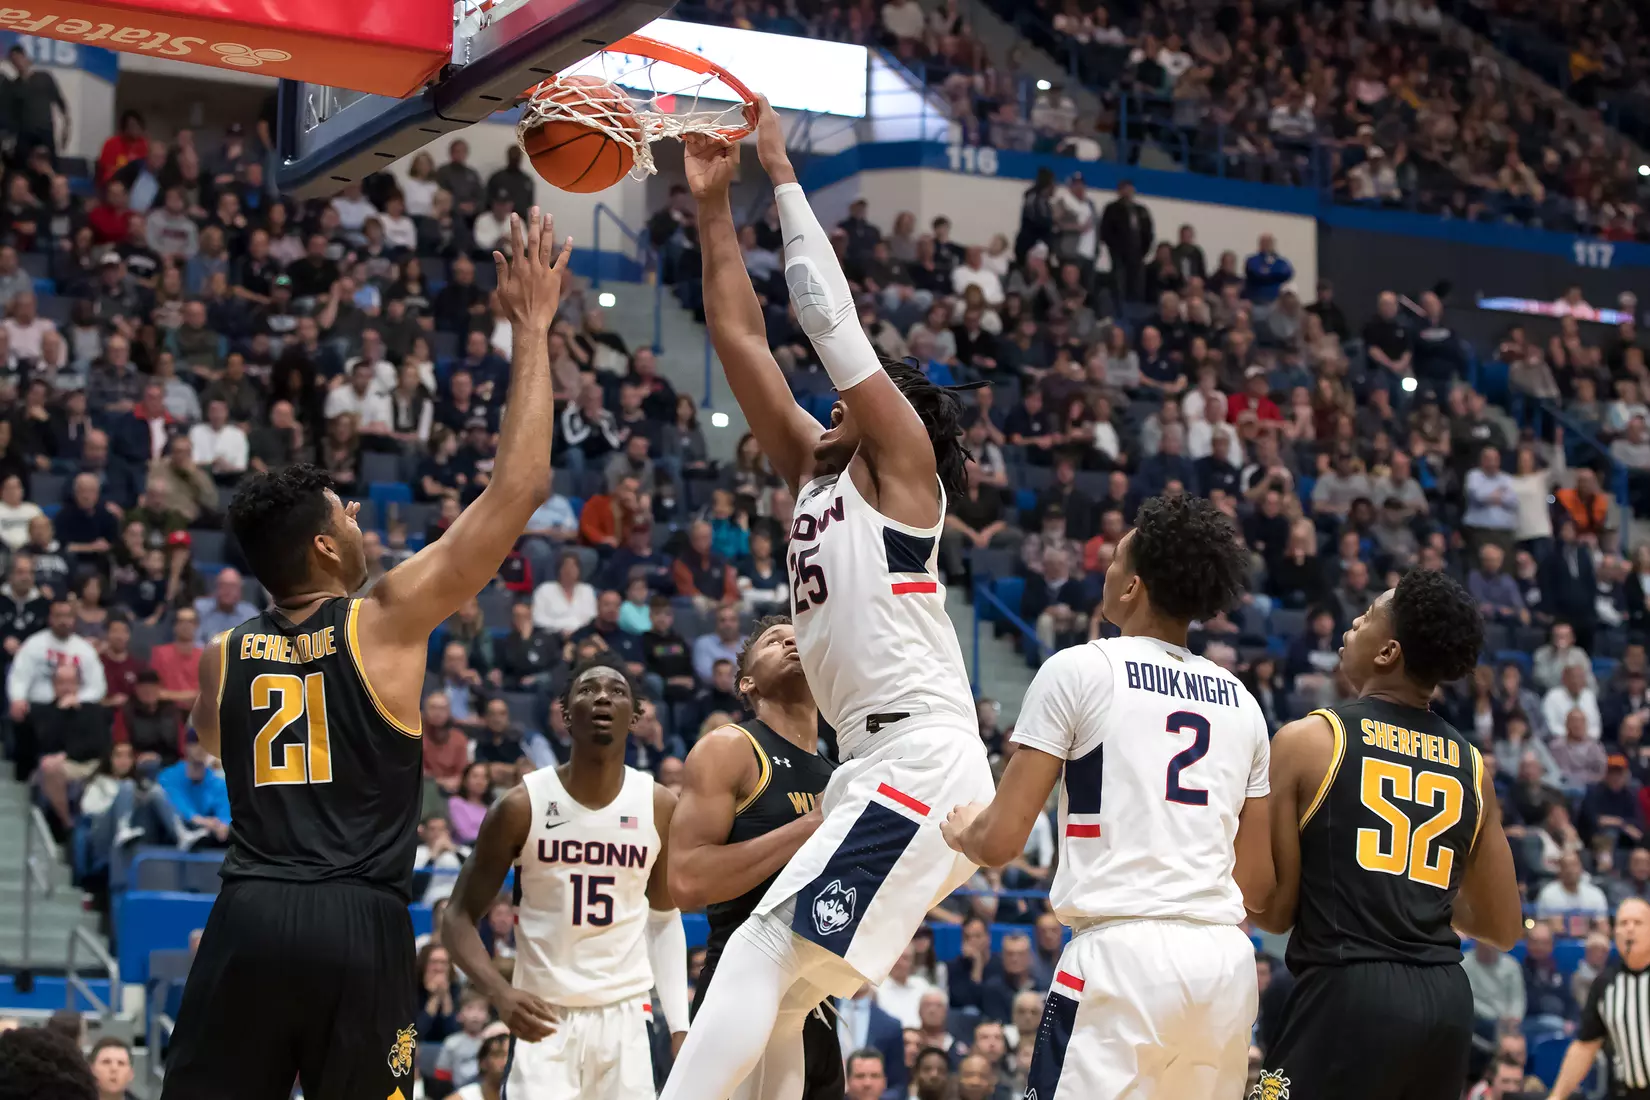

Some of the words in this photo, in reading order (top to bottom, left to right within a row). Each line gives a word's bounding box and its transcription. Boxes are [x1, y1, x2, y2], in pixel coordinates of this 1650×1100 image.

[946, 146, 999, 175] 116
[1573, 241, 1615, 269] 117
[790, 543, 829, 615] 25
[240, 625, 337, 665] ECHEQUE
[1125, 660, 1240, 708] BOUKNIGHT
[251, 671, 333, 788] 21
[1360, 718, 1460, 769] SHERFIELD
[1165, 710, 1211, 807] 2
[1356, 756, 1465, 891] 52
[537, 838, 648, 869] UCONN
[569, 873, 616, 927] 15
